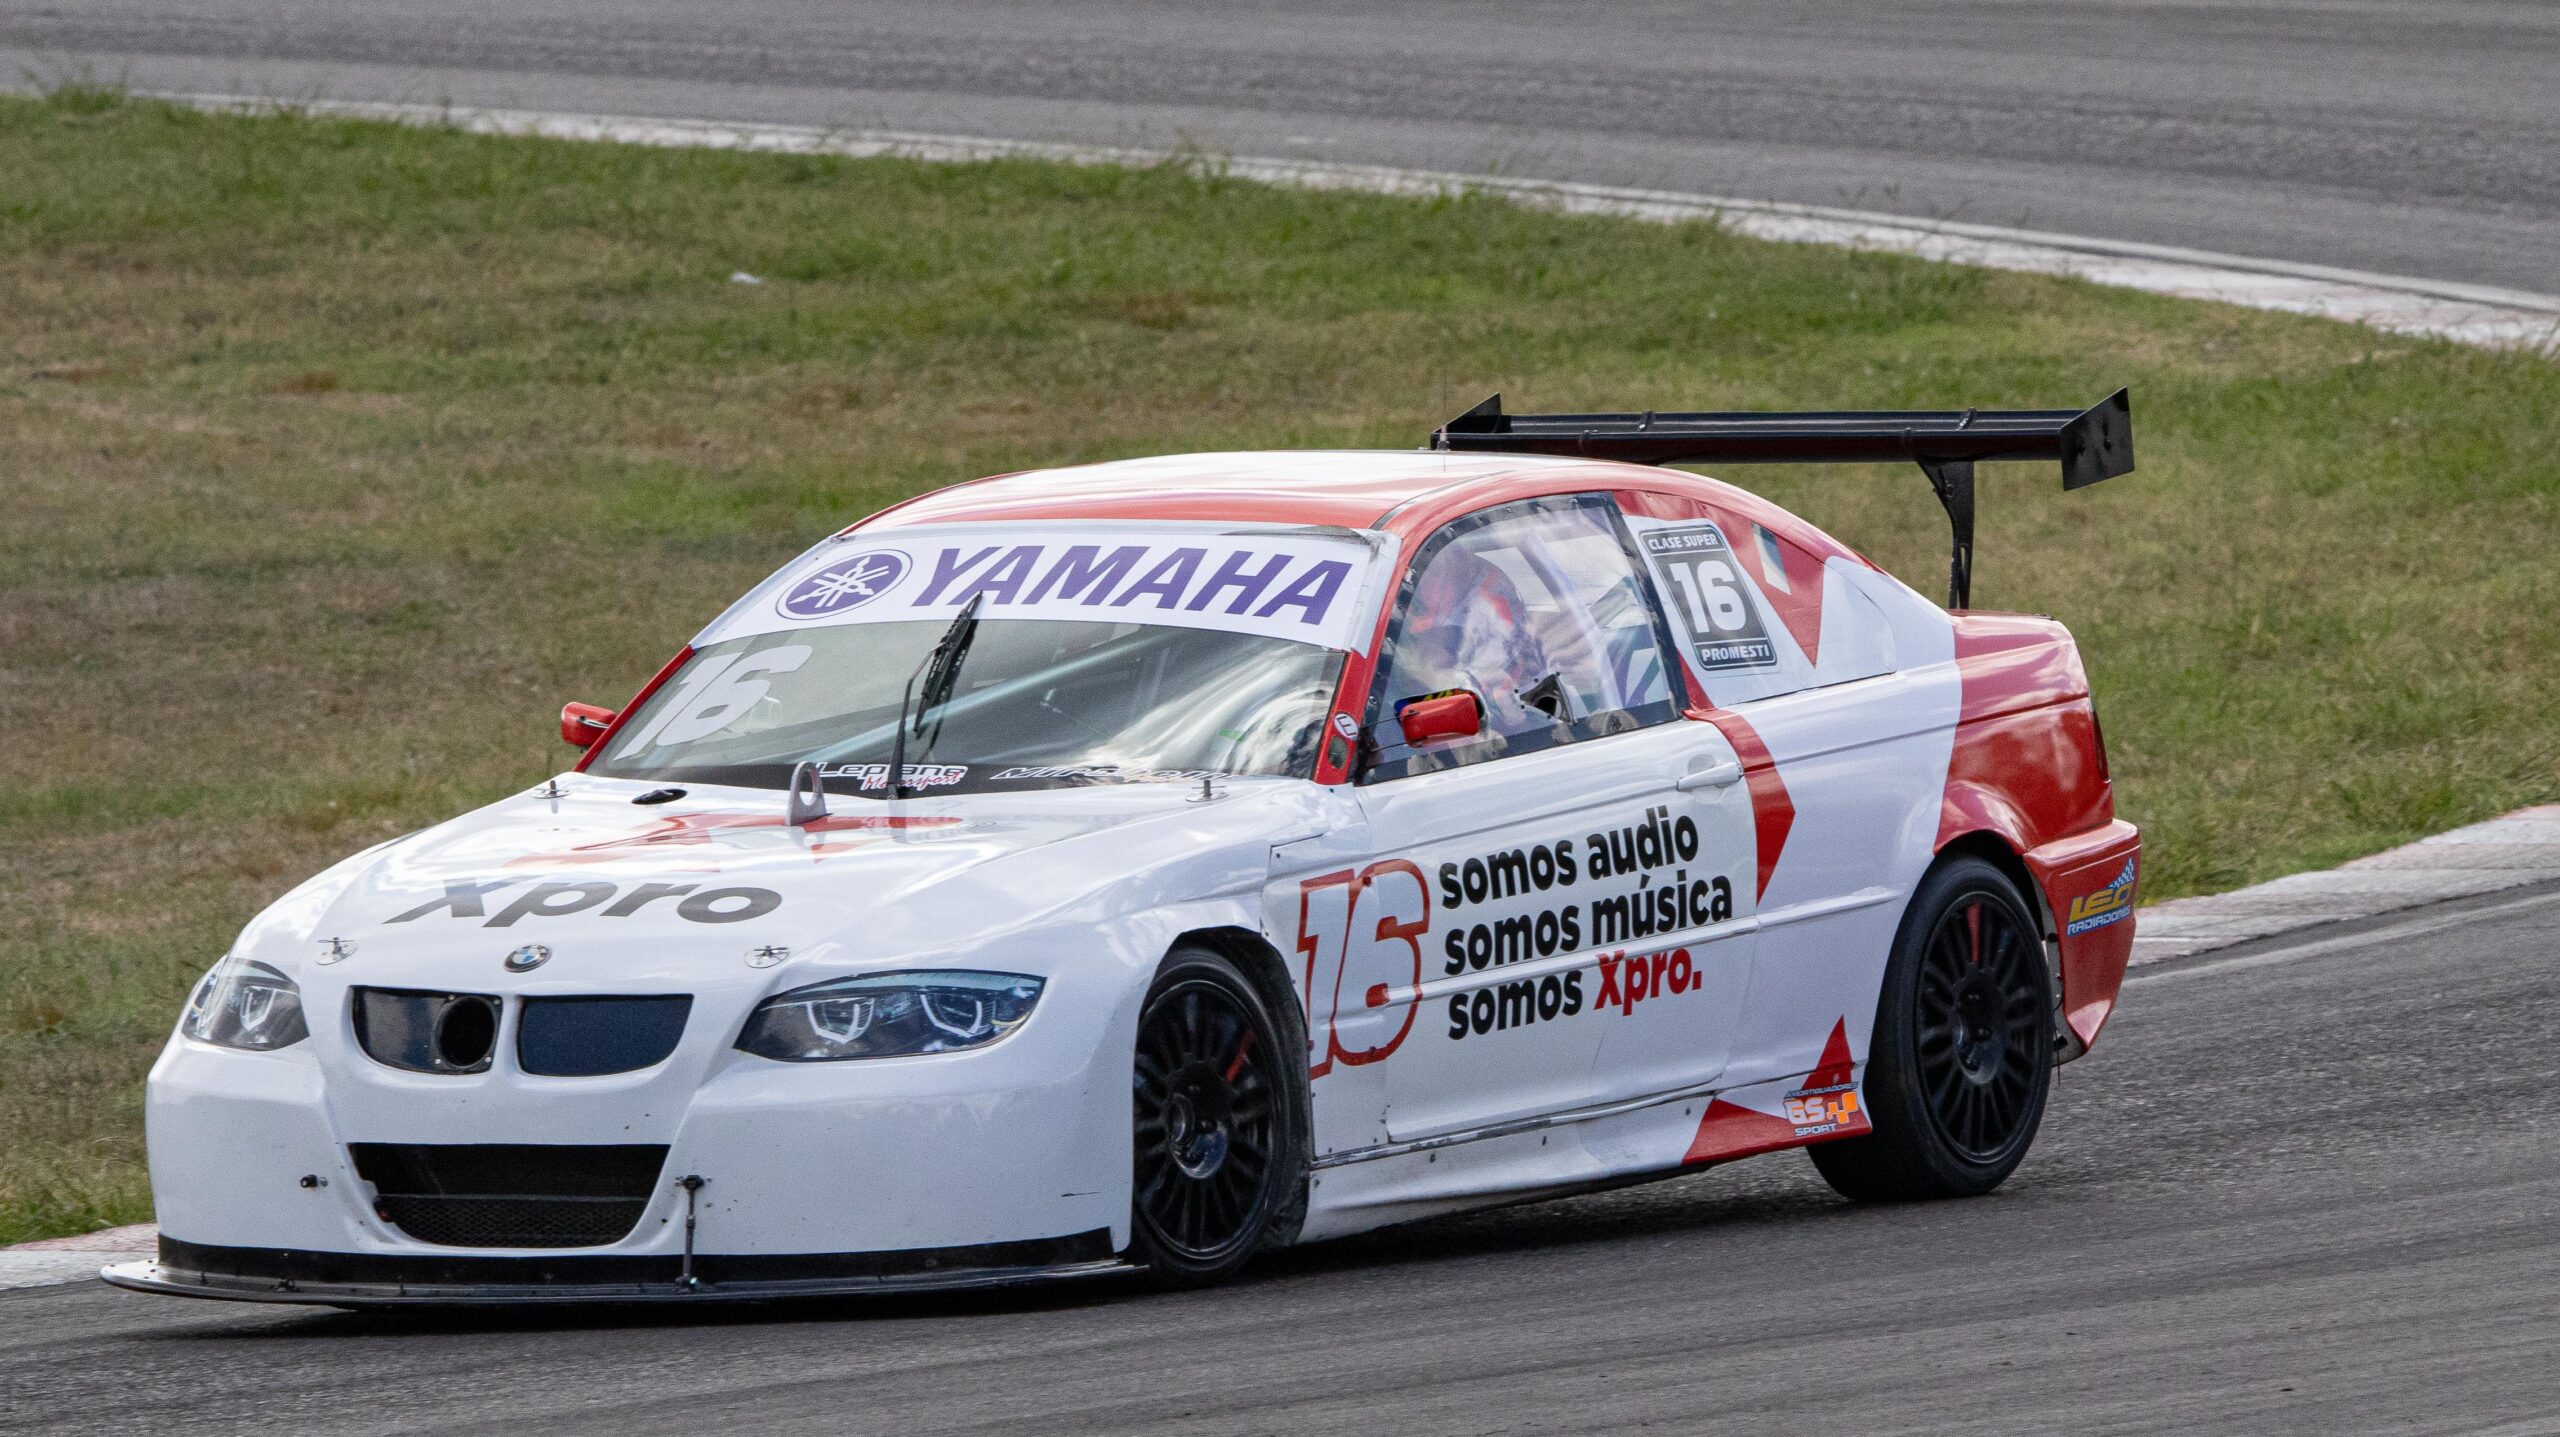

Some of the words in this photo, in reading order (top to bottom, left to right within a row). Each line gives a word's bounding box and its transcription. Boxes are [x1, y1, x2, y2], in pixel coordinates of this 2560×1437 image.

[1649, 536, 1683, 551] CLASE
[1683, 533, 1719, 548] SUPER
[911, 544, 1352, 626] YAMAHA
[1669, 560, 1747, 634] 16
[1701, 644, 1770, 662] PROMESTI
[612, 645, 813, 761] 16
[1439, 839, 1576, 910] somos
[1587, 804, 1699, 881] audio
[381, 876, 783, 927] xpro
[1444, 903, 1581, 977] somos
[1591, 869, 1733, 946] música
[2068, 882, 2134, 923] LEO
[1296, 858, 1430, 1081] 16
[1447, 970, 1583, 1040] somos
[1594, 948, 1703, 1017] Xpro.
[1794, 1122, 1837, 1137] SPORT
